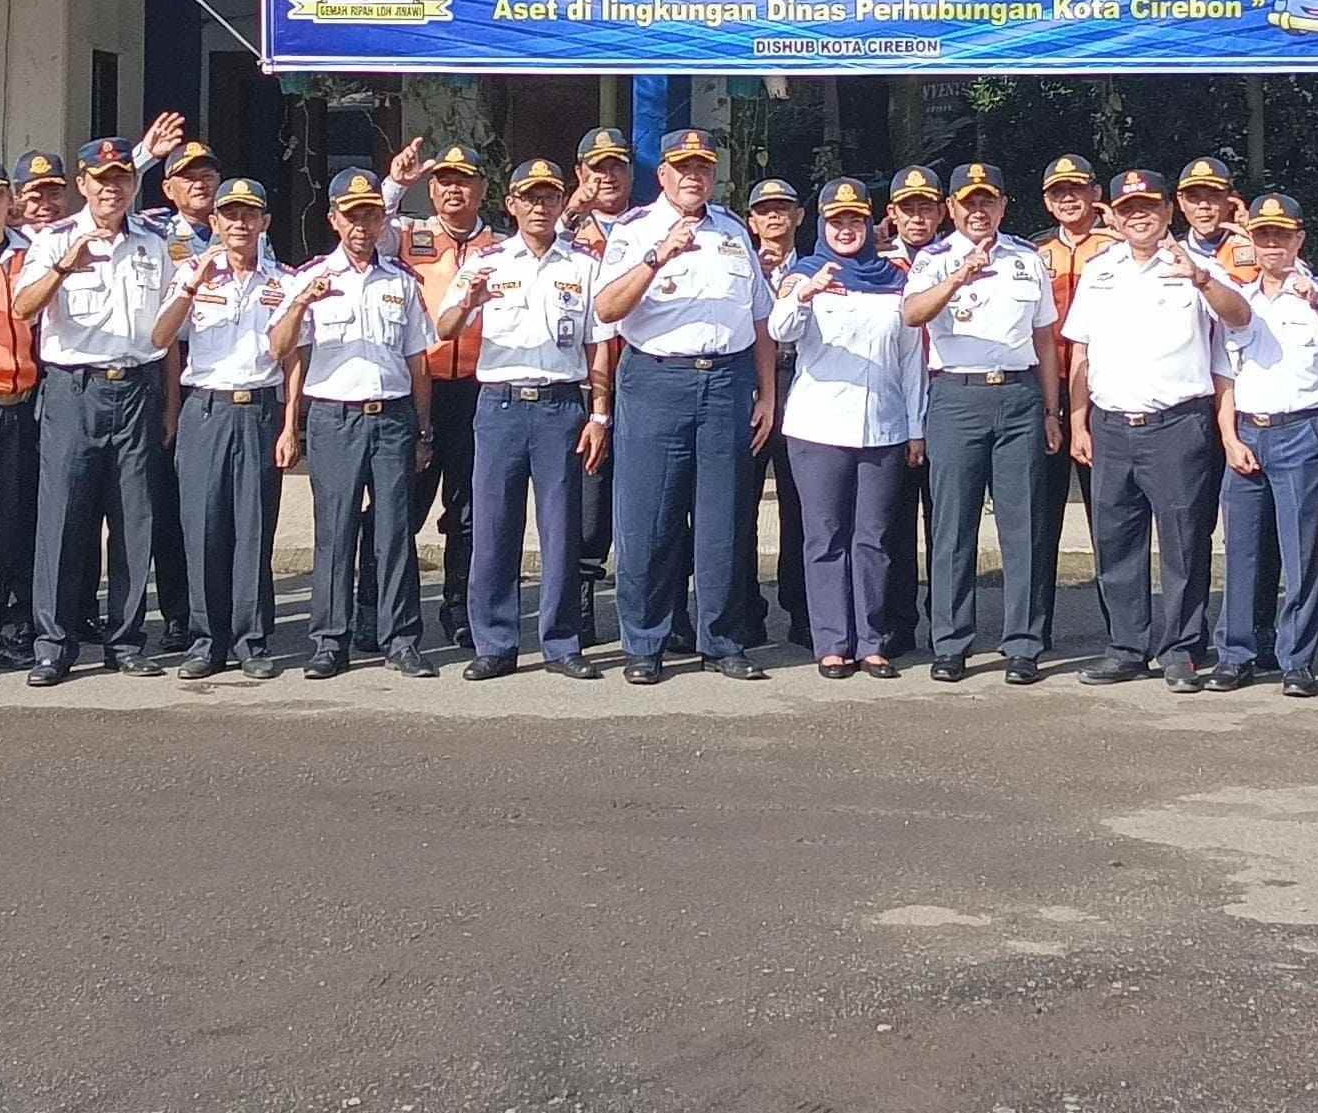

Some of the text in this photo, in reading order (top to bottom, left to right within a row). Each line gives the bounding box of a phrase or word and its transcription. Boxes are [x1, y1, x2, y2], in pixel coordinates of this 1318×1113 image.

[320, 5, 348, 16] GEMAH
[755, 39, 938, 54] DISHUB KOTA CIREBON
